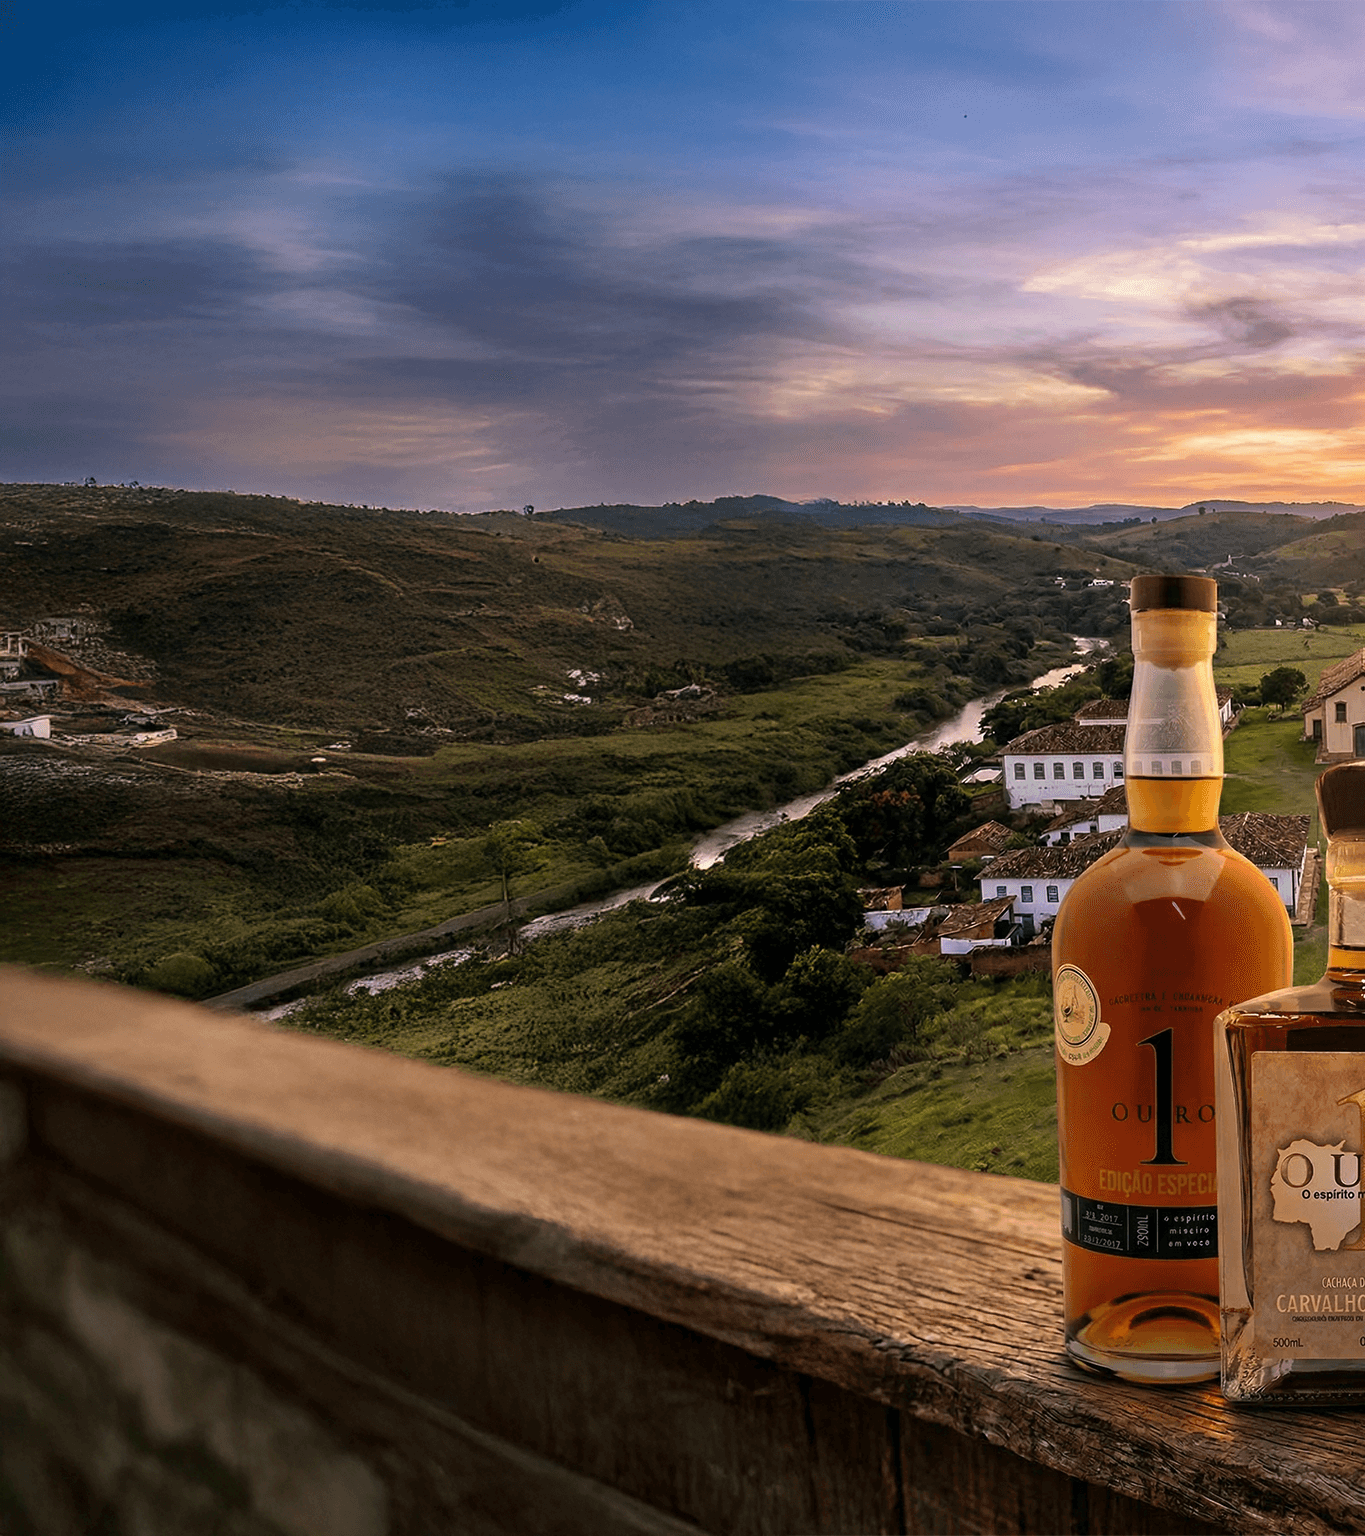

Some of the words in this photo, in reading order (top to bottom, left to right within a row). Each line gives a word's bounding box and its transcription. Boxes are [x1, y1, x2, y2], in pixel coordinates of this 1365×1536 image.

[1136, 1027, 1189, 1166] 1
[1111, 1102, 1216, 1124] OURO
[1099, 1169, 1153, 1198] EDIÇÃO
[1301, 1189, 1311, 1200] O
[1313, 1188, 1355, 1202] espírito
[1321, 1276, 1358, 1290] CACHAÇA
[1272, 1337, 1304, 1348] 500mL
